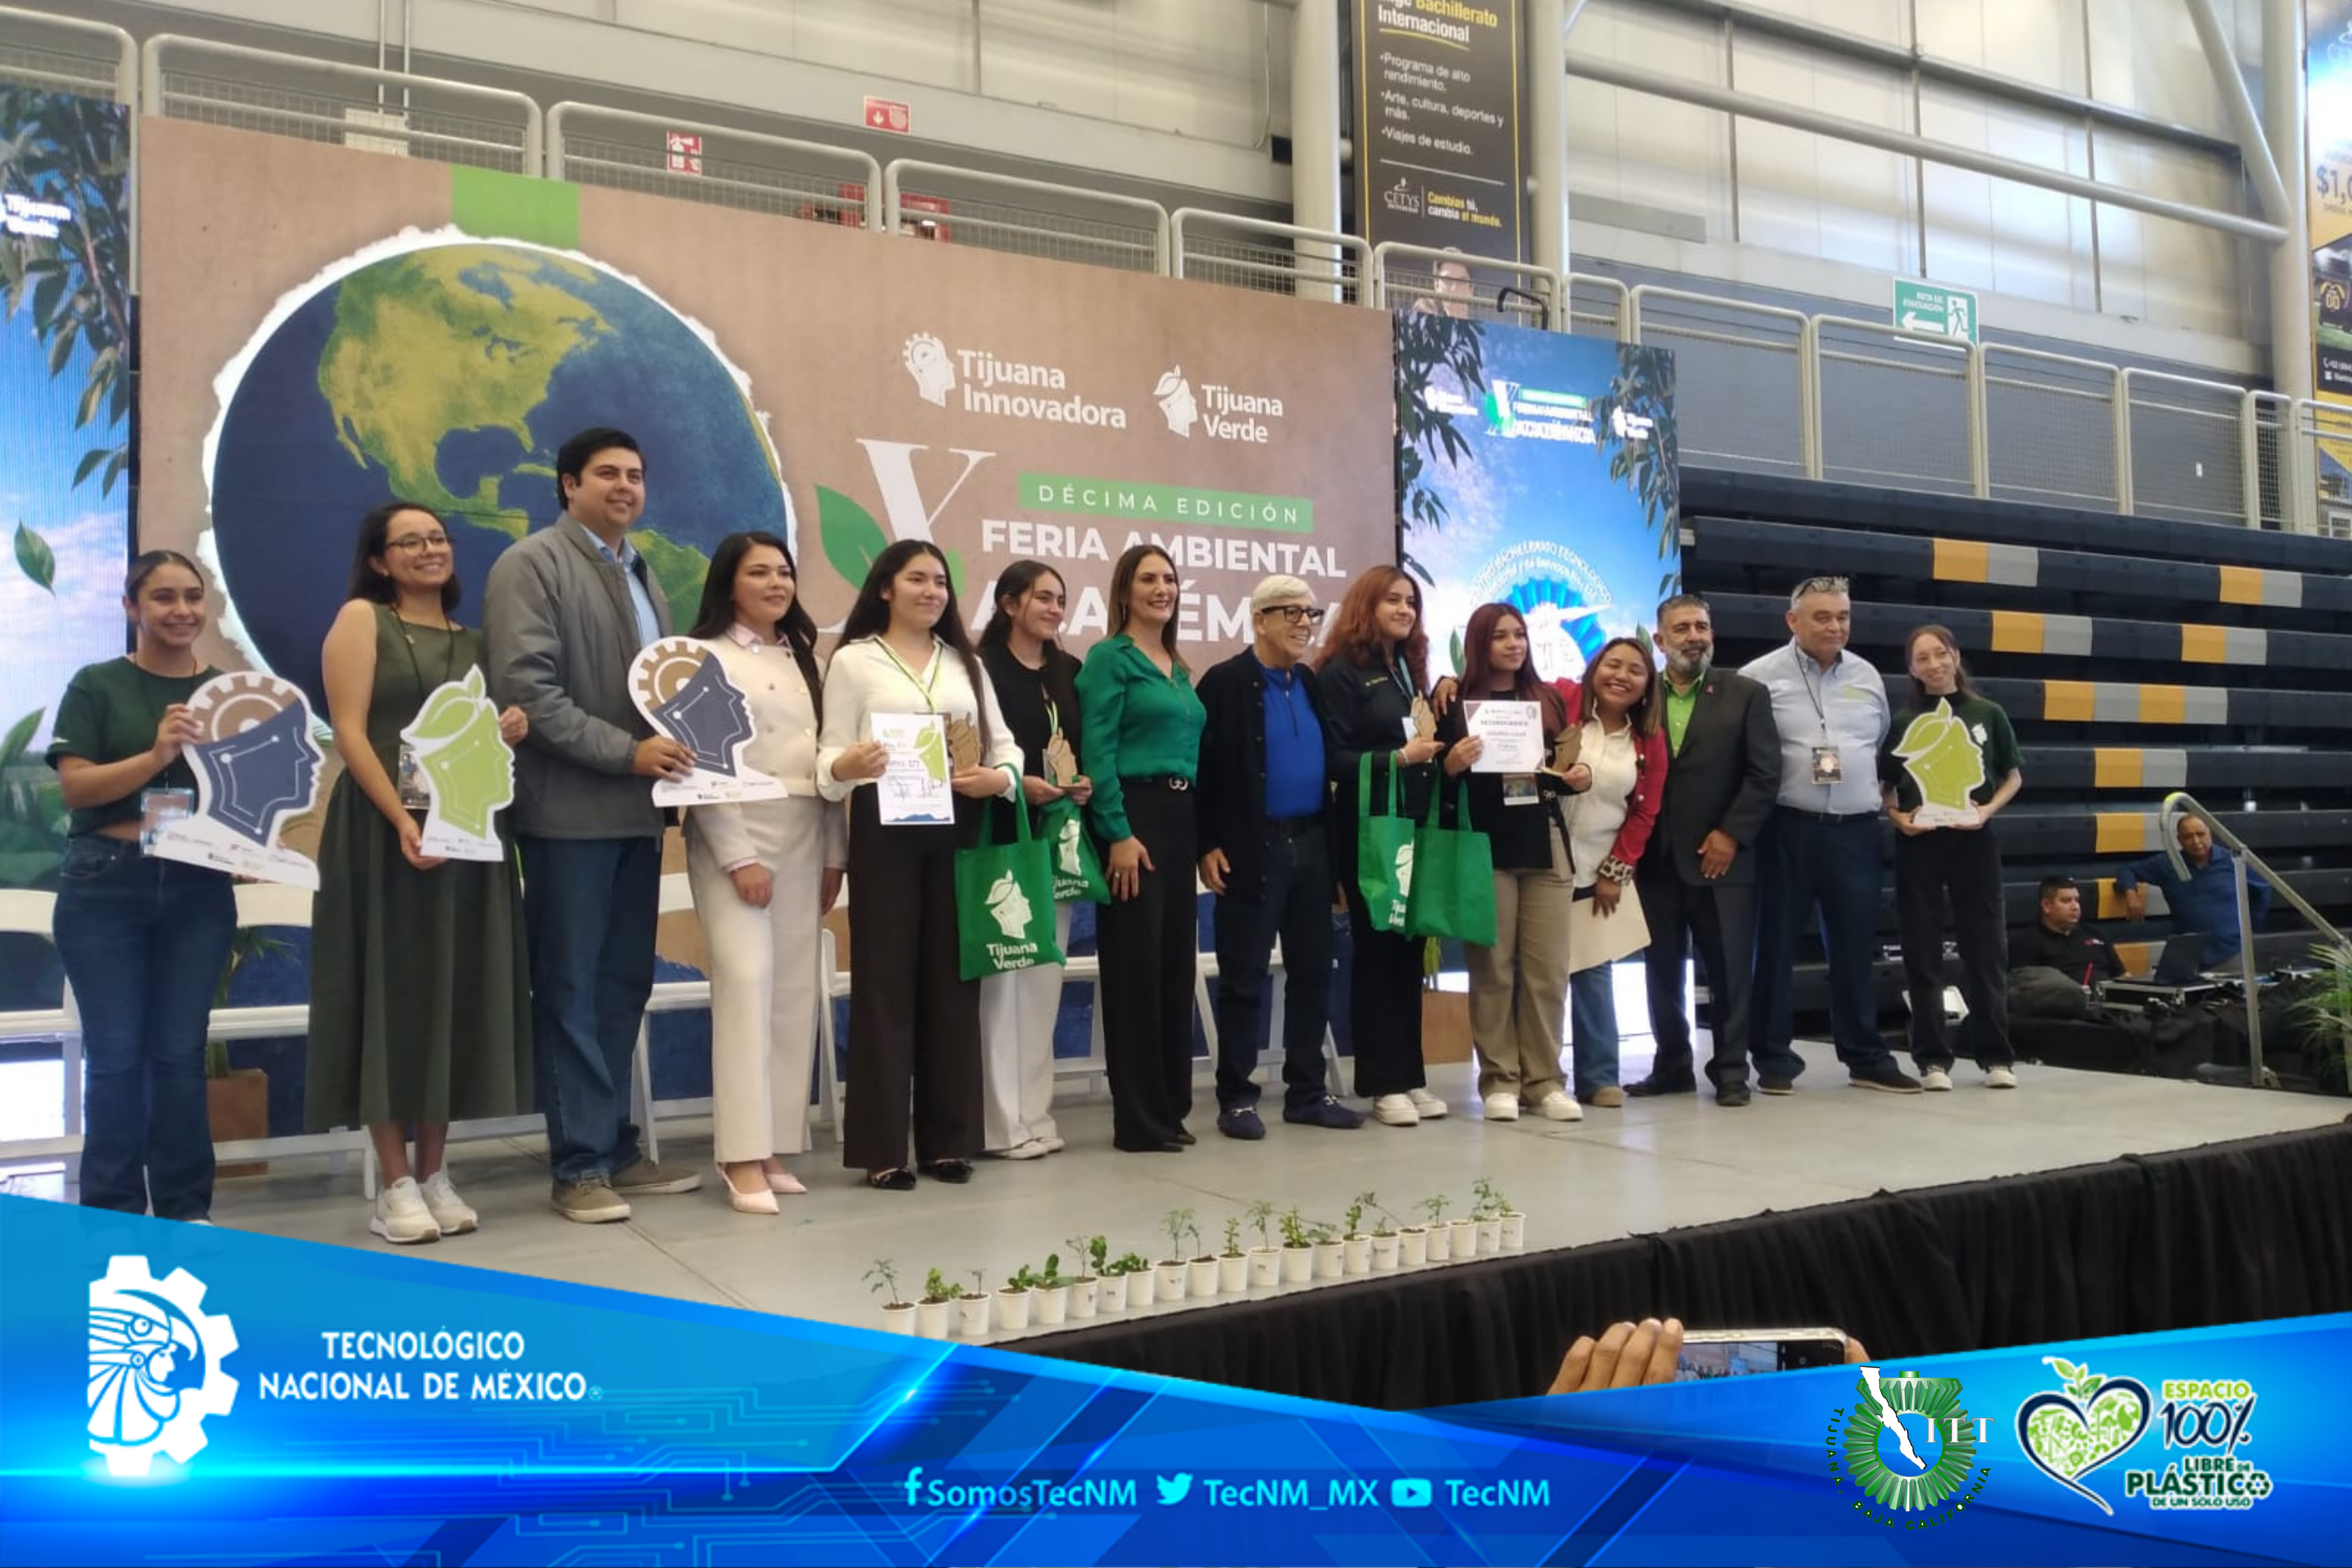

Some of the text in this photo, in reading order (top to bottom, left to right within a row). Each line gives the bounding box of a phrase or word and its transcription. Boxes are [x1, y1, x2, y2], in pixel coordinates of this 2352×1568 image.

[1378, 5, 1470, 43] Internacional
[1384, 52, 1471, 83] Programa de alto
[1452, 104, 1496, 124] deportes
[1497, 115, 1504, 129] y
[1385, 126, 1416, 144] Viajes
[1418, 133, 1432, 146] de
[1384, 191, 1420, 207] CETYS
[957, 349, 1066, 390] Tijuana
[964, 384, 1127, 428] Innovadora
[1201, 384, 1283, 417] Tijuana
[1203, 414, 1268, 443] Verde
[1038, 483, 1297, 524] DÉCIMA EDICIÓN
[981, 518, 1109, 561] FERIA
[1053, 888, 1082, 900] erde
[987, 942, 1038, 959] Tijuana
[993, 956, 1034, 970] Verde
